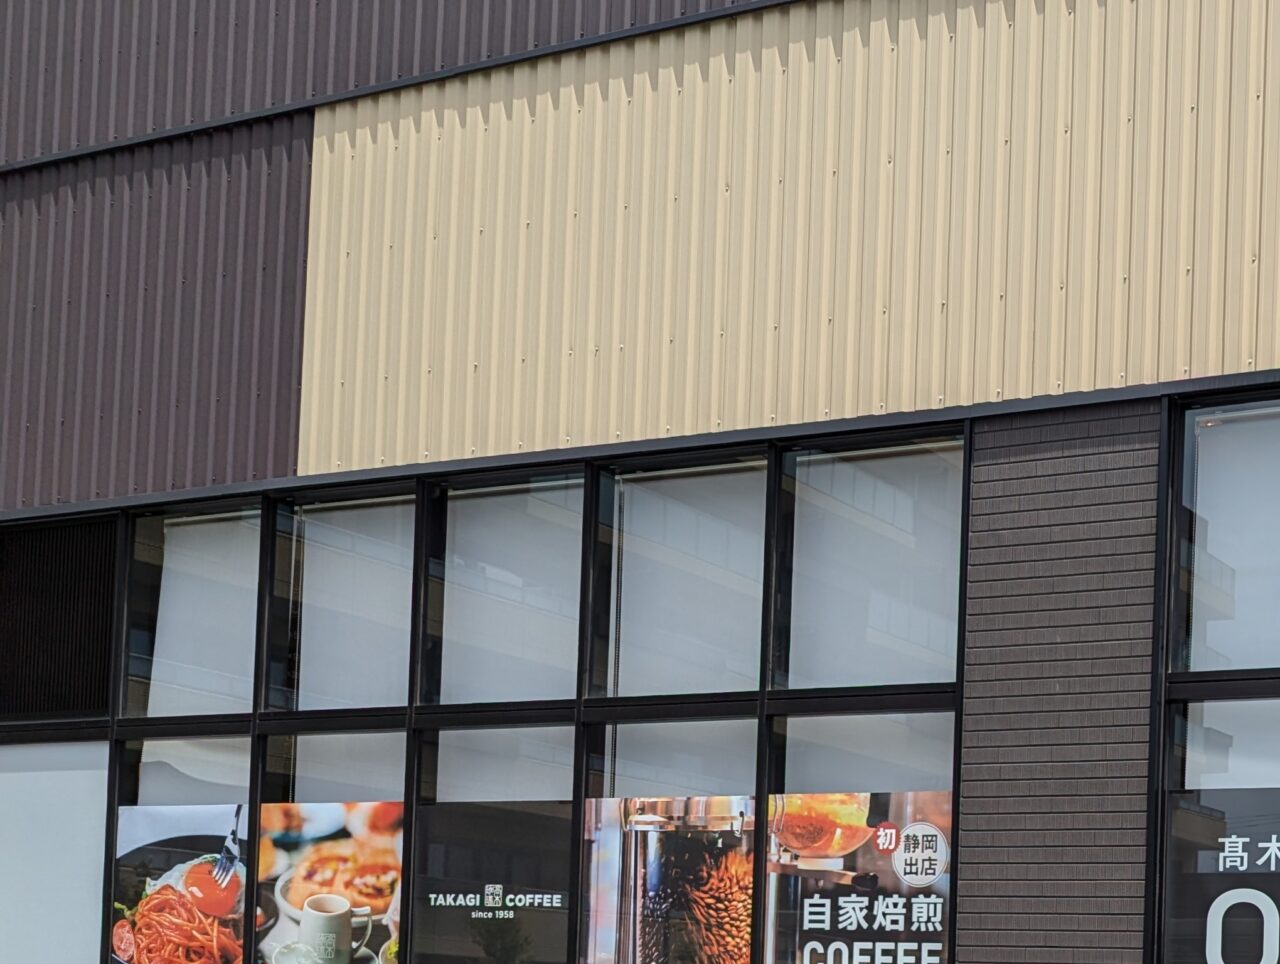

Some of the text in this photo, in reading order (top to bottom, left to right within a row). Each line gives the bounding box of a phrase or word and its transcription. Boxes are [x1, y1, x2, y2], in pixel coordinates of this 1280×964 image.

[877, 828, 897, 850] 初
[904, 833, 938, 853] 静岡
[904, 856, 938, 876] 出店
[429, 894, 480, 907] TAKAGI
[506, 894, 562, 907] COFFEE
[471, 910, 515, 919] since 1958
[802, 893, 944, 932] 自家焙煎
